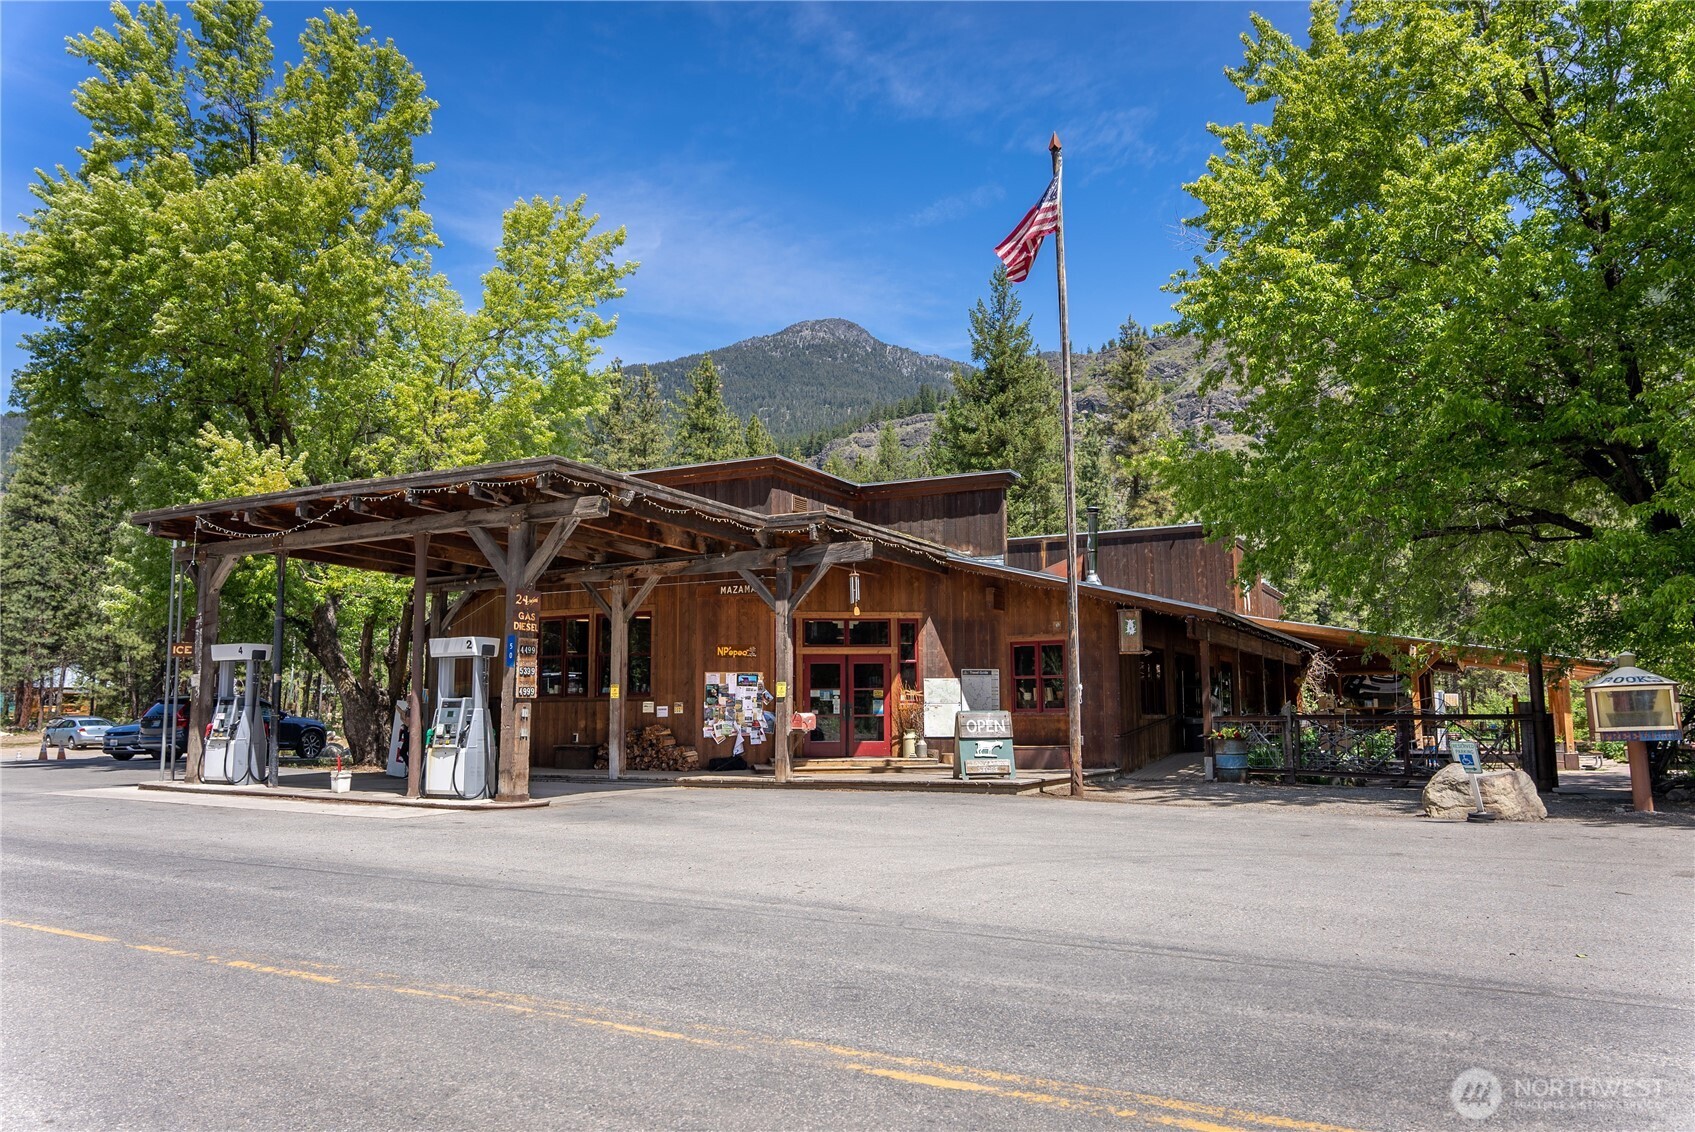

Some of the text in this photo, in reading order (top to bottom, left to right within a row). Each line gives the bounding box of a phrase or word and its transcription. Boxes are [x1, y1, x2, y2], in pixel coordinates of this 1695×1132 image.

[515, 593, 529, 606] 24
[518, 611, 536, 621] GAS
[513, 621, 539, 632] DIESEL
[466, 640, 472, 649] 2
[172, 645, 193, 655] ICE
[238, 646, 243, 655] 4
[966, 719, 1006, 733] OPEN
